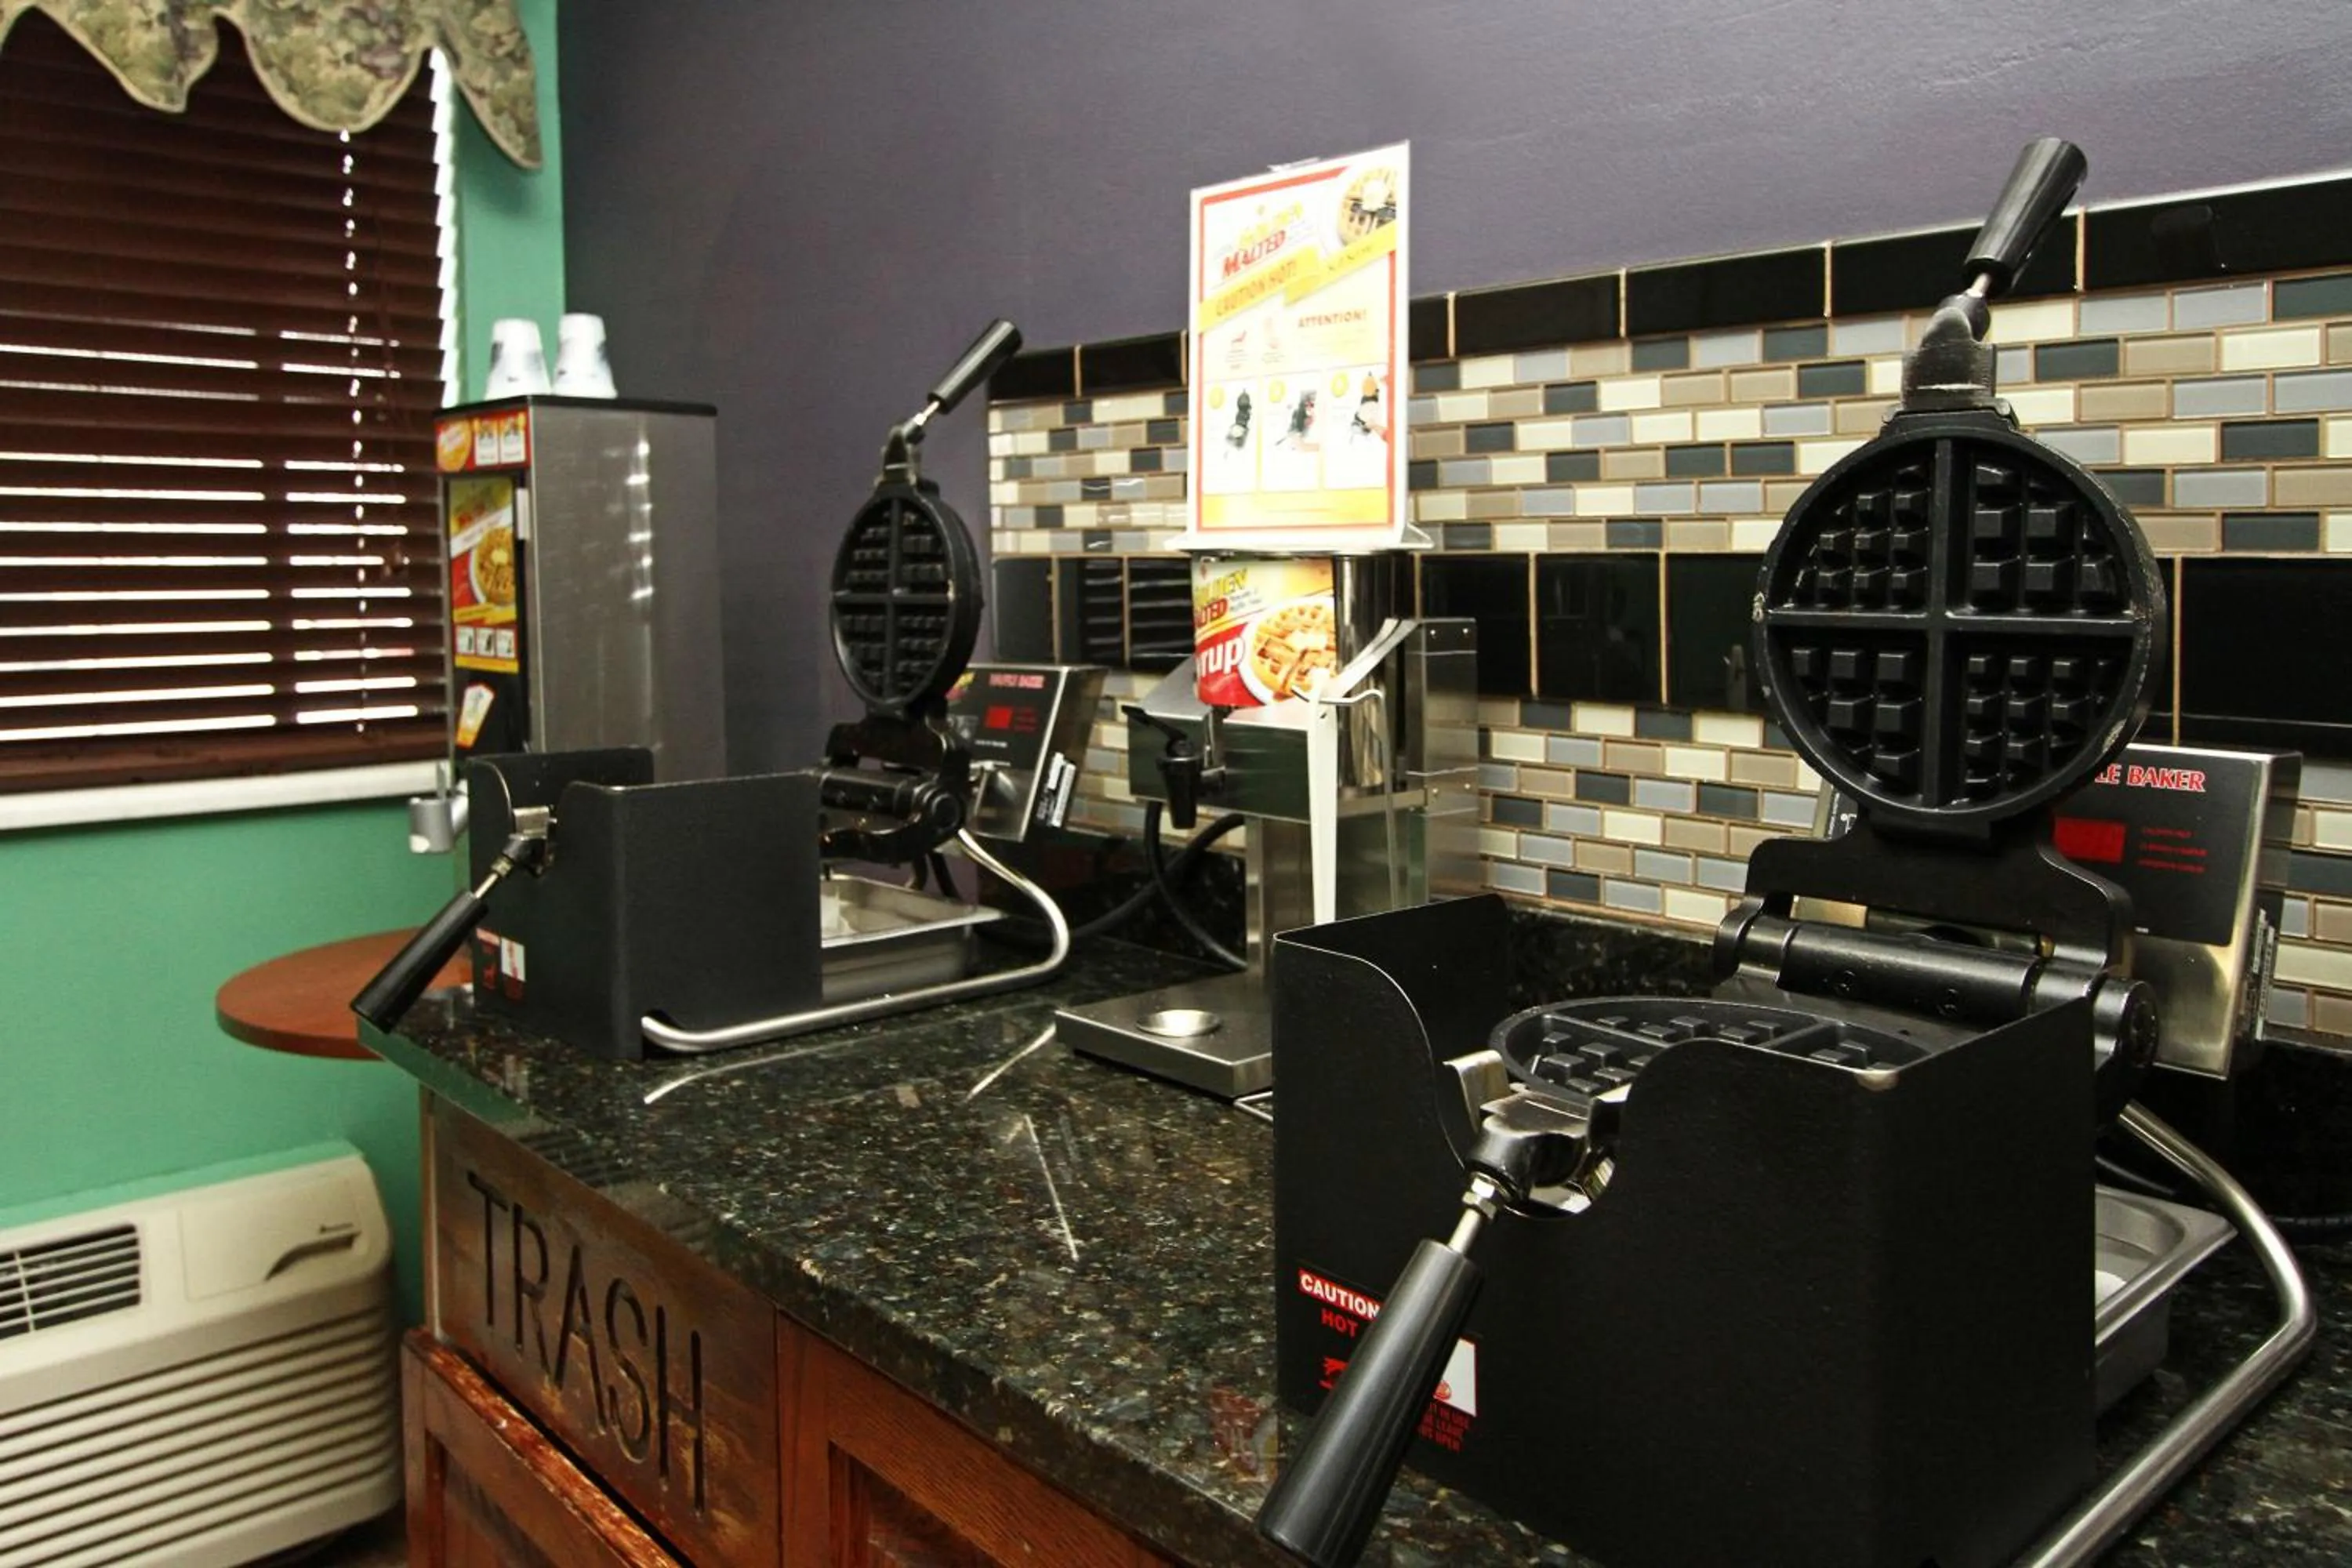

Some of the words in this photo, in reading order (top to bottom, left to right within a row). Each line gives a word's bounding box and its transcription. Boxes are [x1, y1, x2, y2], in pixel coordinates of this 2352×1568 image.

[1298, 308, 1367, 328] ATTENTION!
[1198, 636, 1246, 678] rup
[2127, 764, 2206, 793] BAKER
[1300, 1273, 1381, 1320] CAUTION
[1321, 1308, 1359, 1338] HOT
[467, 1171, 705, 1515] TRASH
